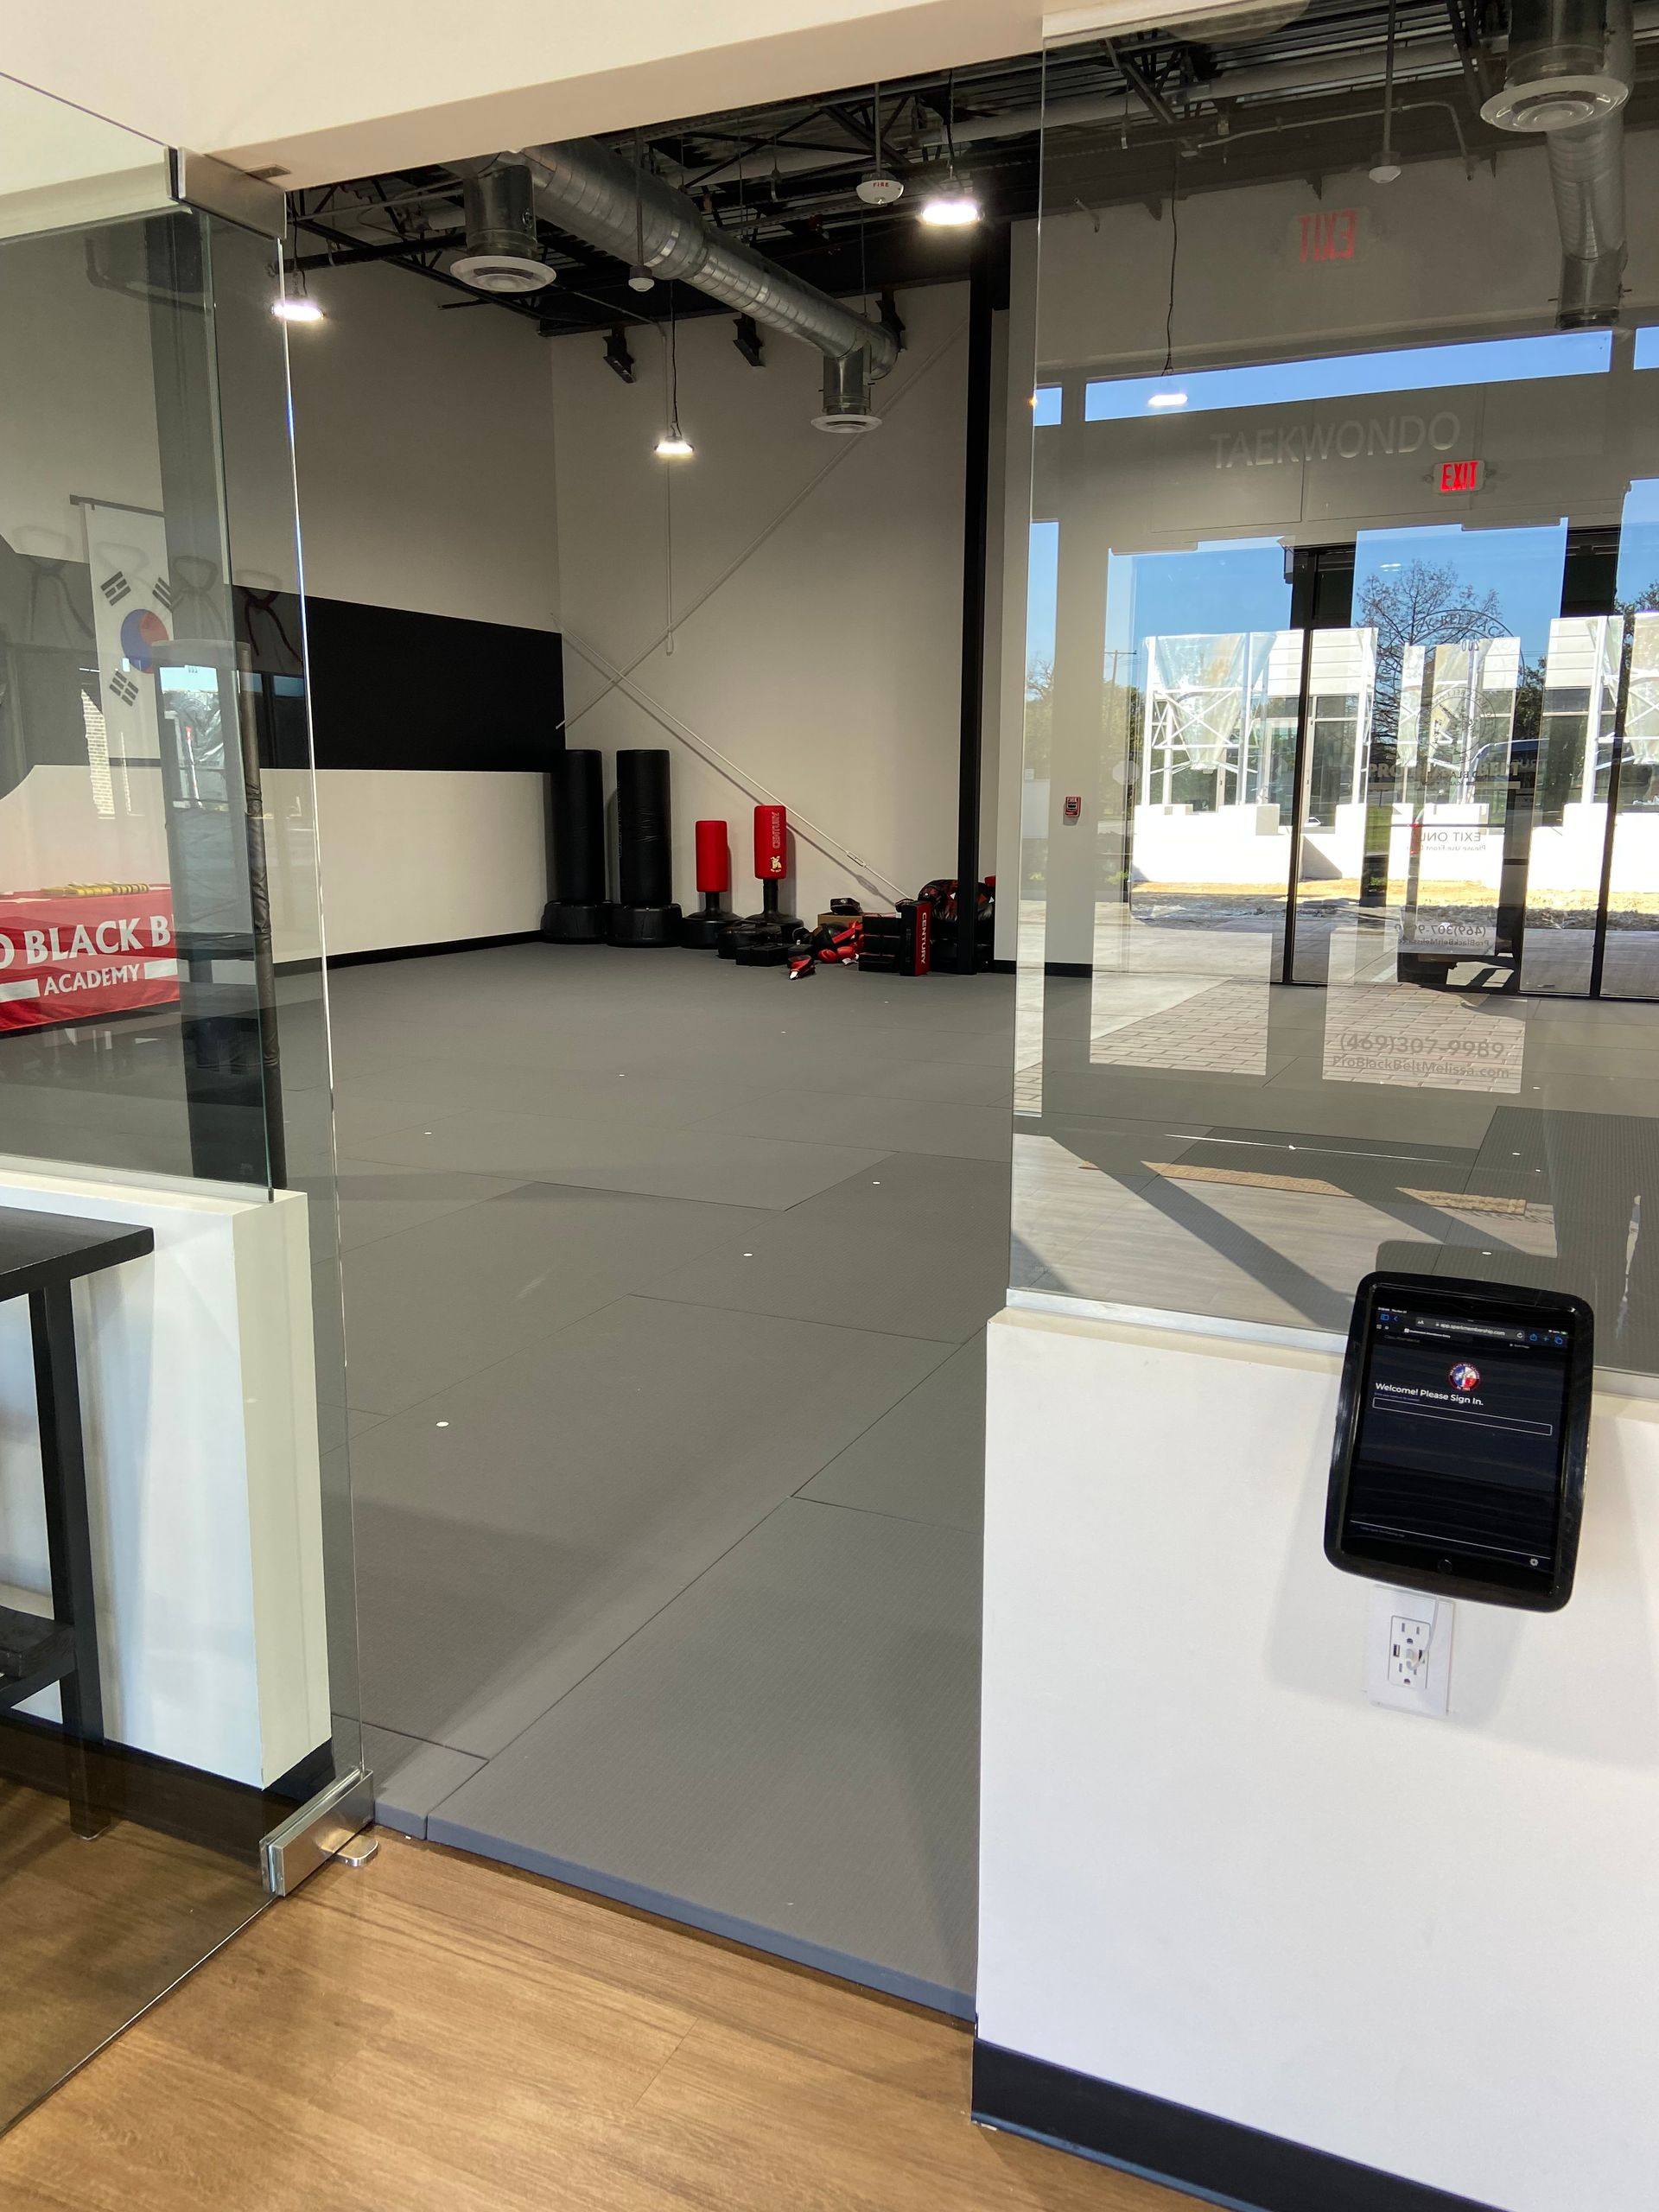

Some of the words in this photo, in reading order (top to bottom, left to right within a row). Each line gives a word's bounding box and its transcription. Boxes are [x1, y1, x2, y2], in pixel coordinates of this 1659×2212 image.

[1210, 411, 1460, 469] TAEKWONDO
[1440, 461, 1478, 492] EXIT
[23, 918, 144, 965] BLACK
[44, 963, 141, 996] ACADEMY
[1340, 1033, 1505, 1059] (469)307-9989
[1332, 1055, 1510, 1079] ProBlackBeltMelissa.com
[1375, 1382, 1419, 1395] Welcome!
[1420, 1389, 1449, 1402] Please
[1450, 1394, 1471, 1406] Sign
[1471, 1397, 1484, 1406] In.
